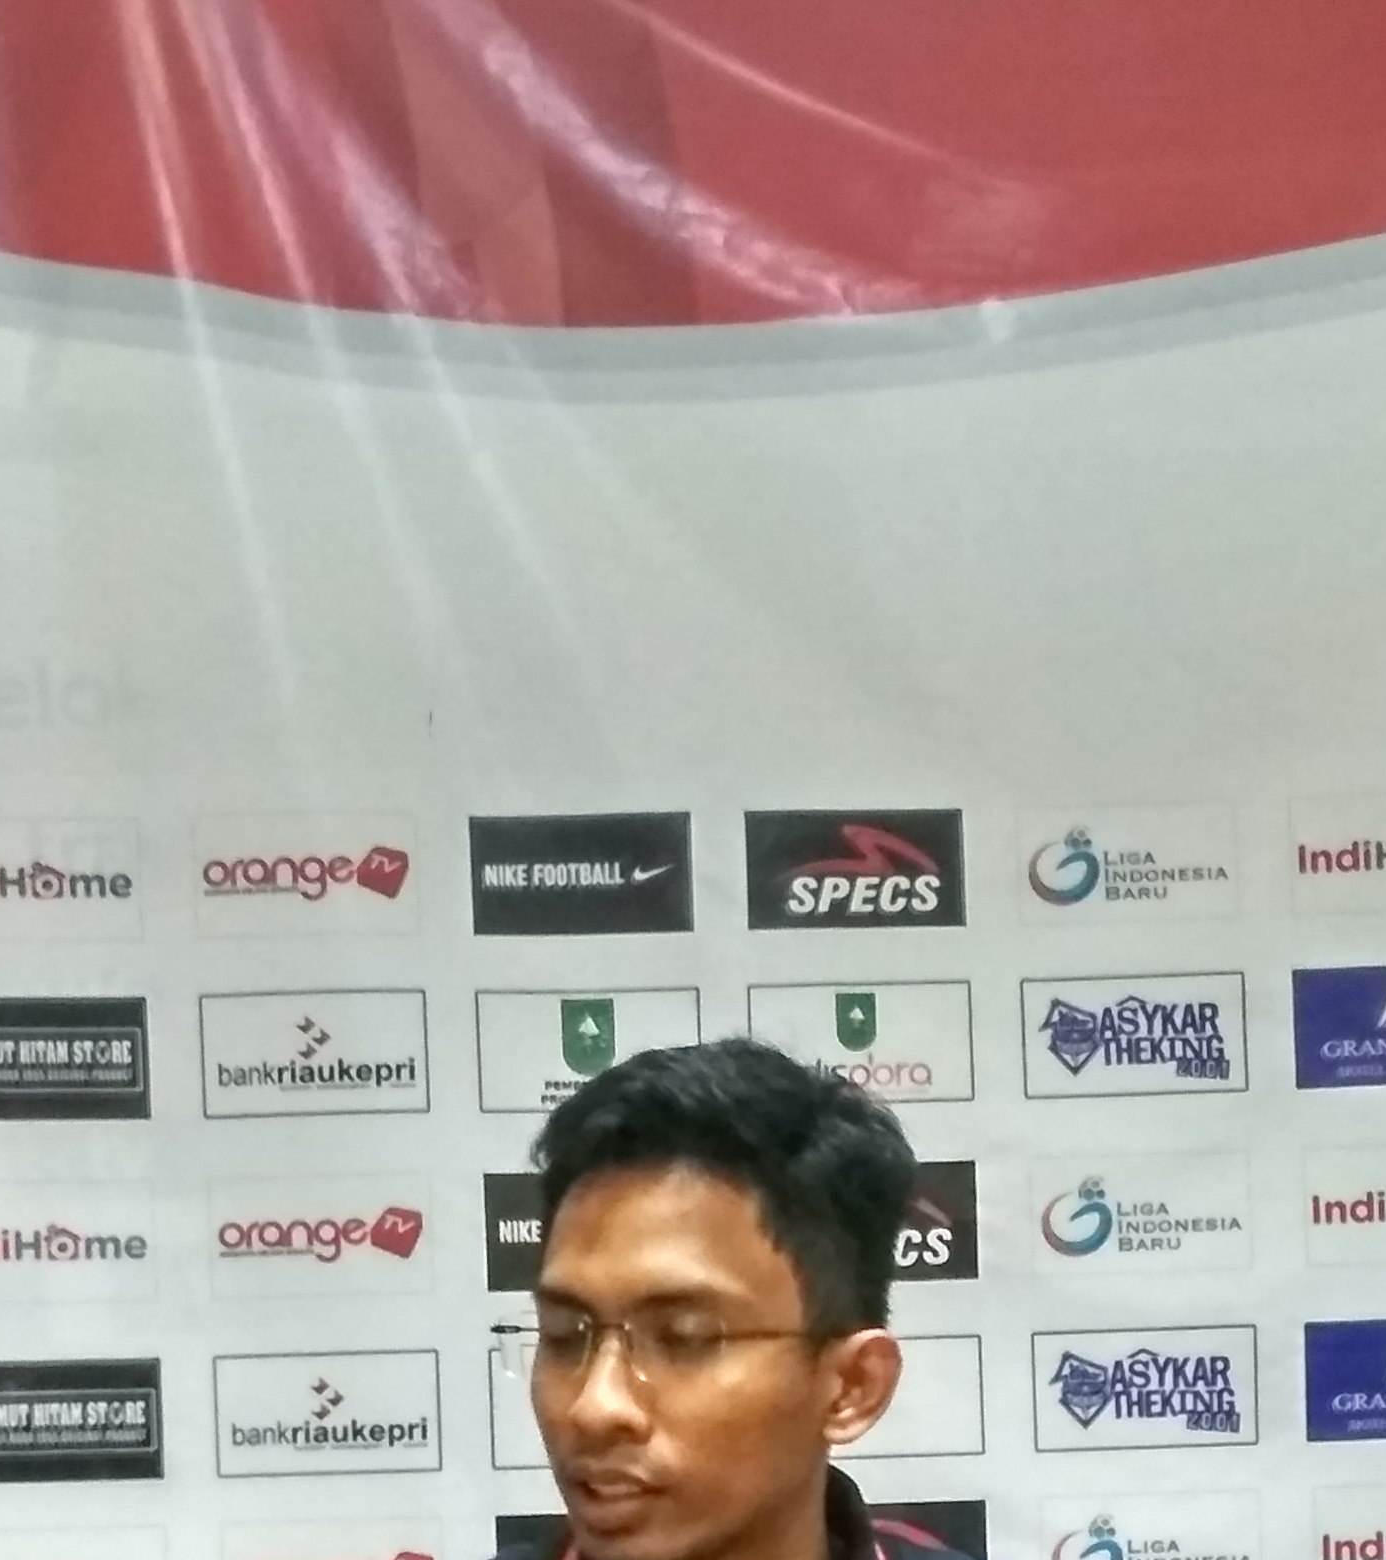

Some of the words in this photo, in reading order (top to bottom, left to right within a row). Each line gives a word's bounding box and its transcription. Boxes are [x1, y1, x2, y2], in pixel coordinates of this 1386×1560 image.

[204, 857, 355, 902] orange
[484, 863, 528, 889] NIKE
[532, 861, 625, 888] FOOTBALL
[789, 875, 940, 915] SPECS
[19, 1040, 69, 1064] HITAM
[73, 1040, 132, 1064] STORE
[218, 1057, 416, 1087] bankriaukepri
[219, 1218, 369, 1262] orange
[499, 1219, 541, 1244] NIKE
[86, 1400, 147, 1426] STORE
[231, 1417, 428, 1447] bankriaukepri
